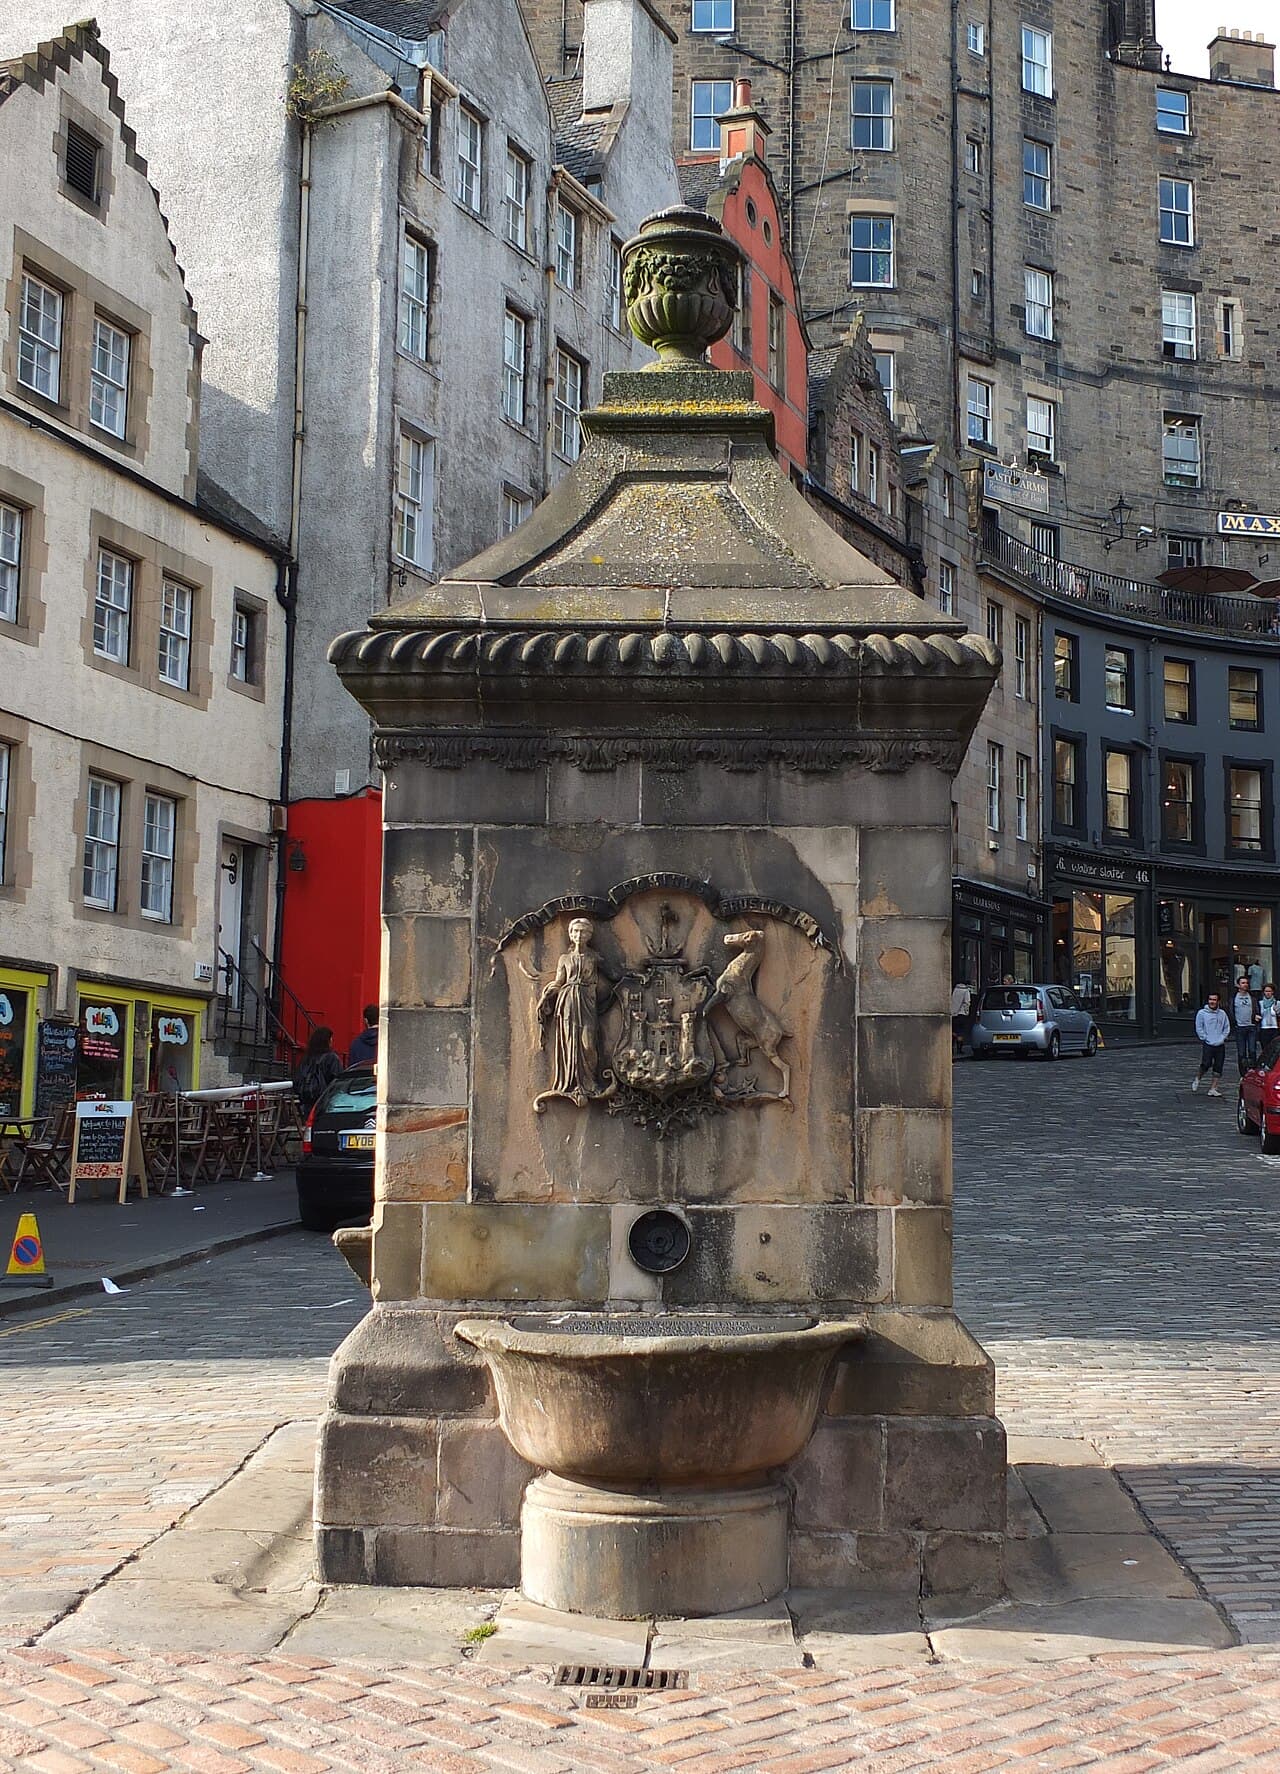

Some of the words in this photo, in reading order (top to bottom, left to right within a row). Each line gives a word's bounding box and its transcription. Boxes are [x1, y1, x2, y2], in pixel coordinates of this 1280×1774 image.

[1020, 478, 1045, 493] ARMS
[1099, 866, 1125, 880] slater
[348, 1135, 374, 1146] LY06
